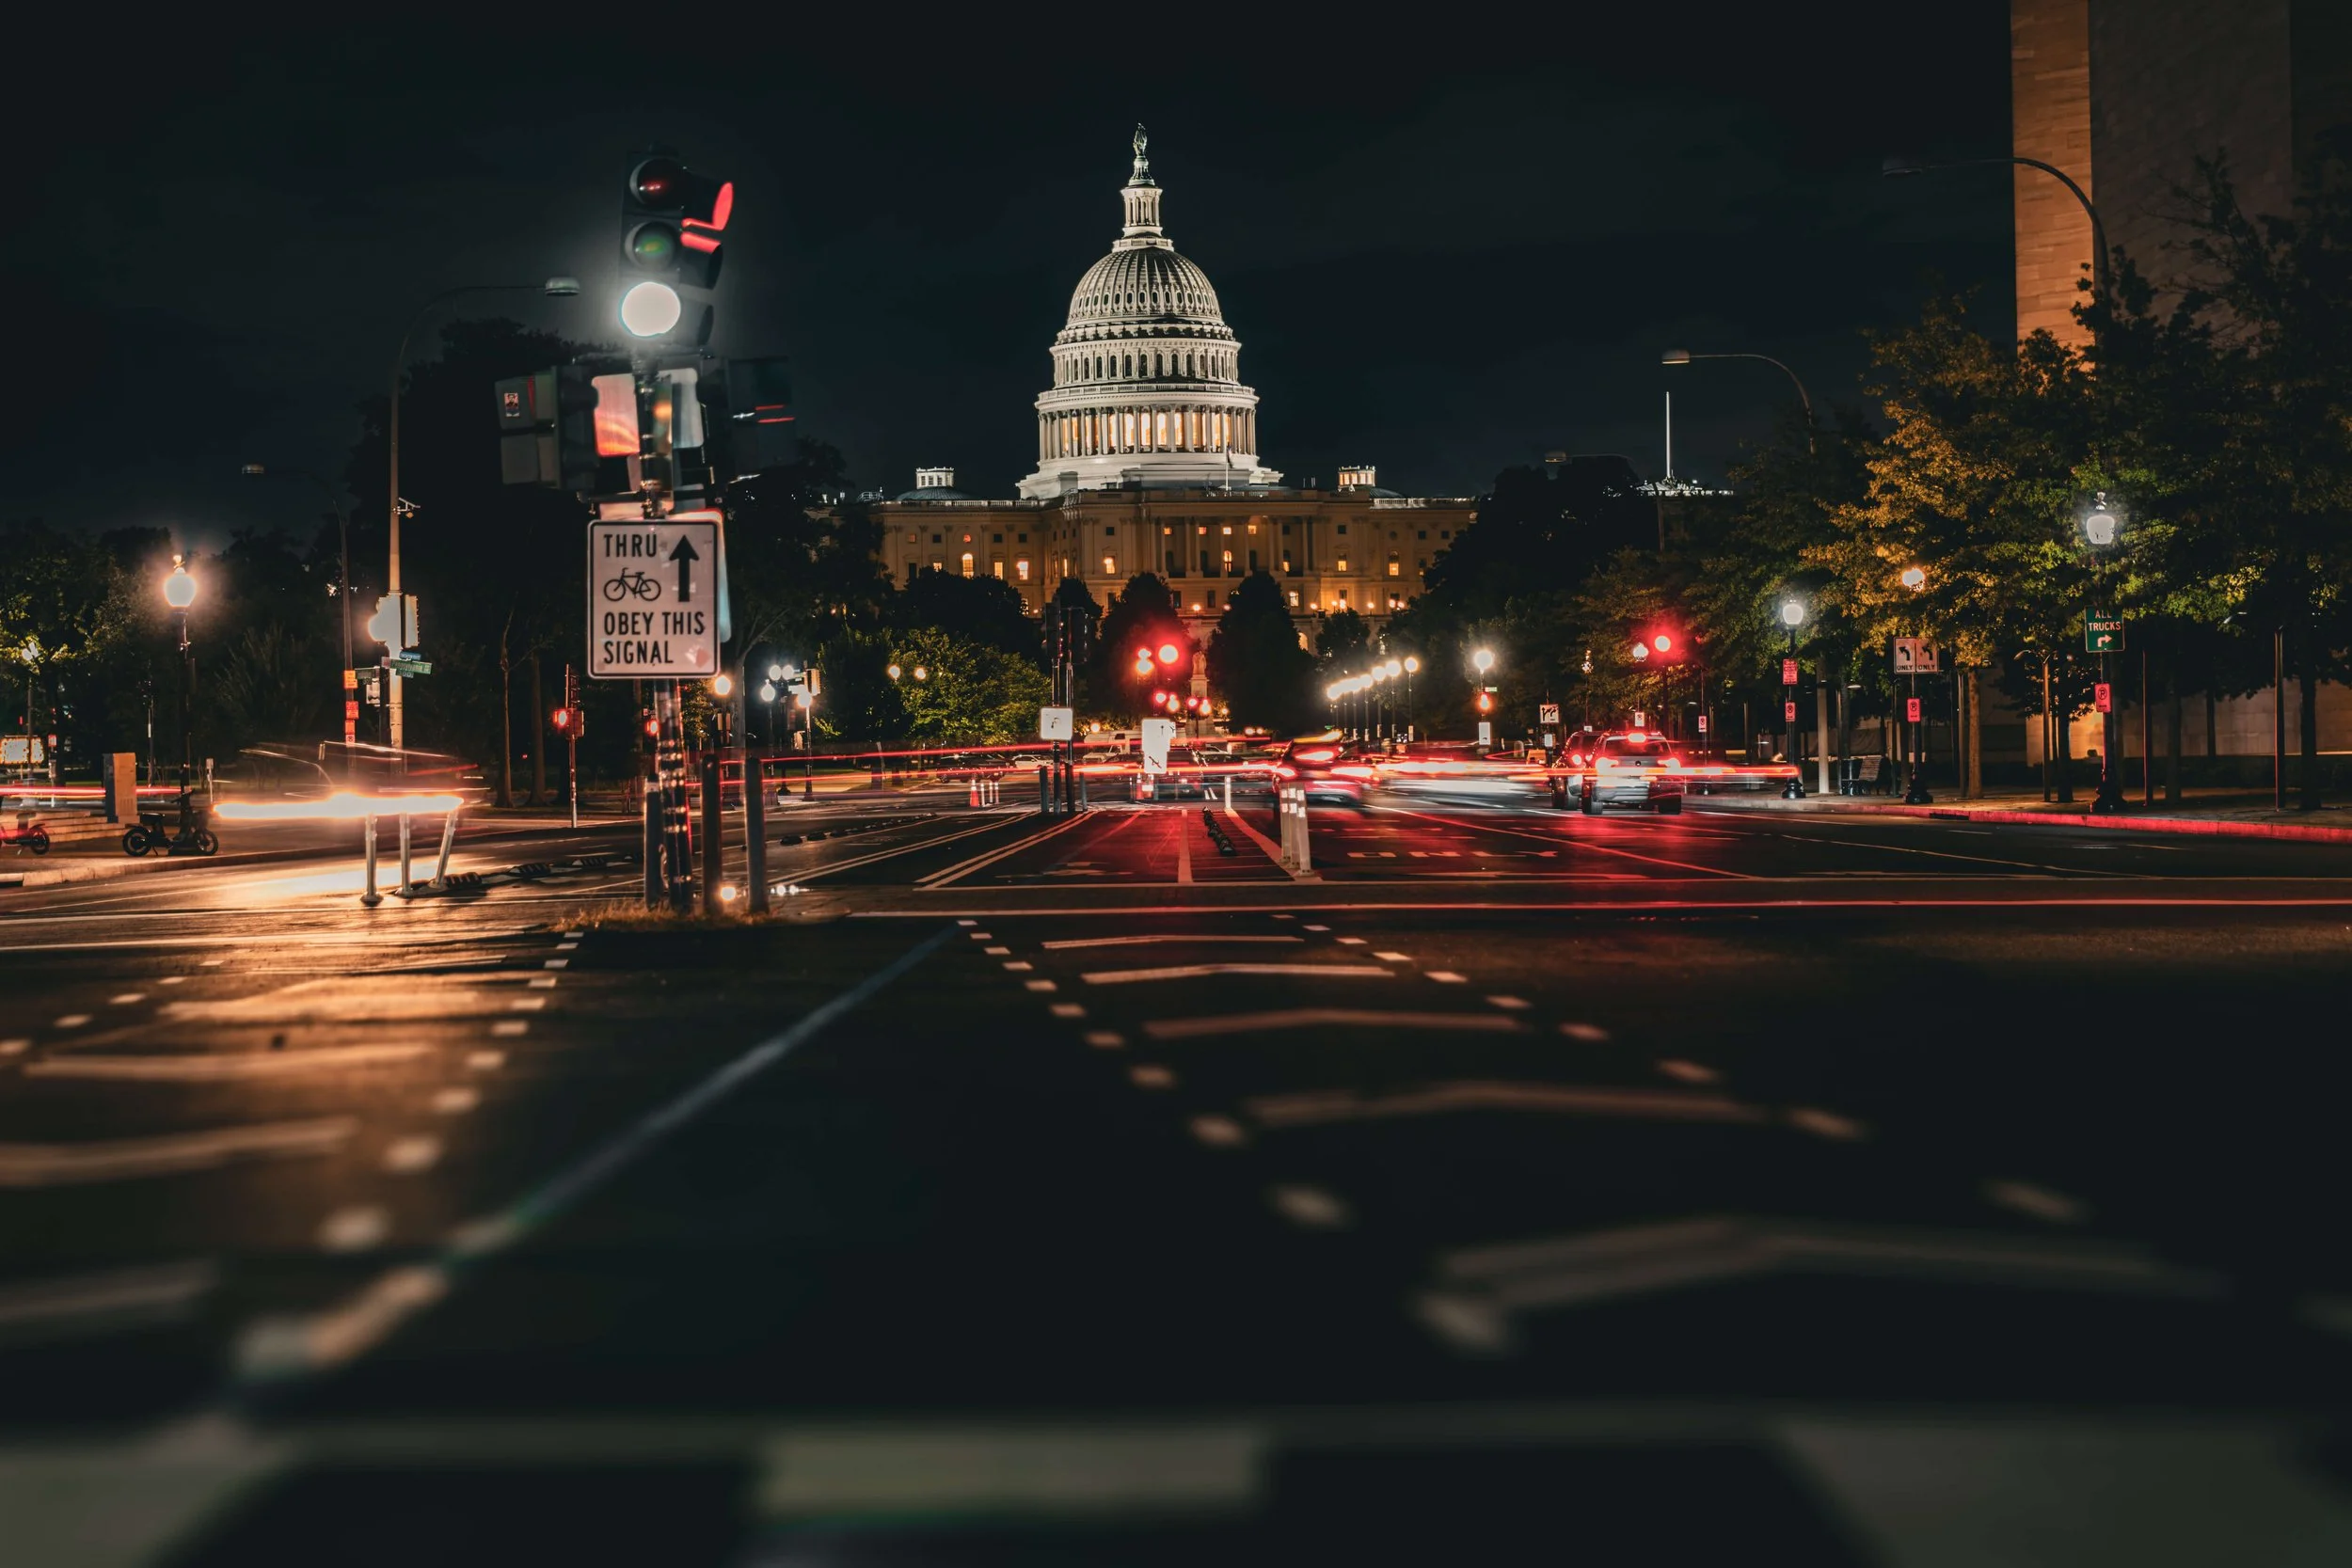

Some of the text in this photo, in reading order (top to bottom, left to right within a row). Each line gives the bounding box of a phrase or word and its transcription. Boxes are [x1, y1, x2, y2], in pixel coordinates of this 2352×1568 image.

[604, 533, 657, 558] THRU
[604, 612, 705, 635] OBEY THIS
[2095, 610, 2112, 619] ALL
[2089, 622, 2122, 631] TRUCKS
[604, 641, 674, 664] SIGNAL
